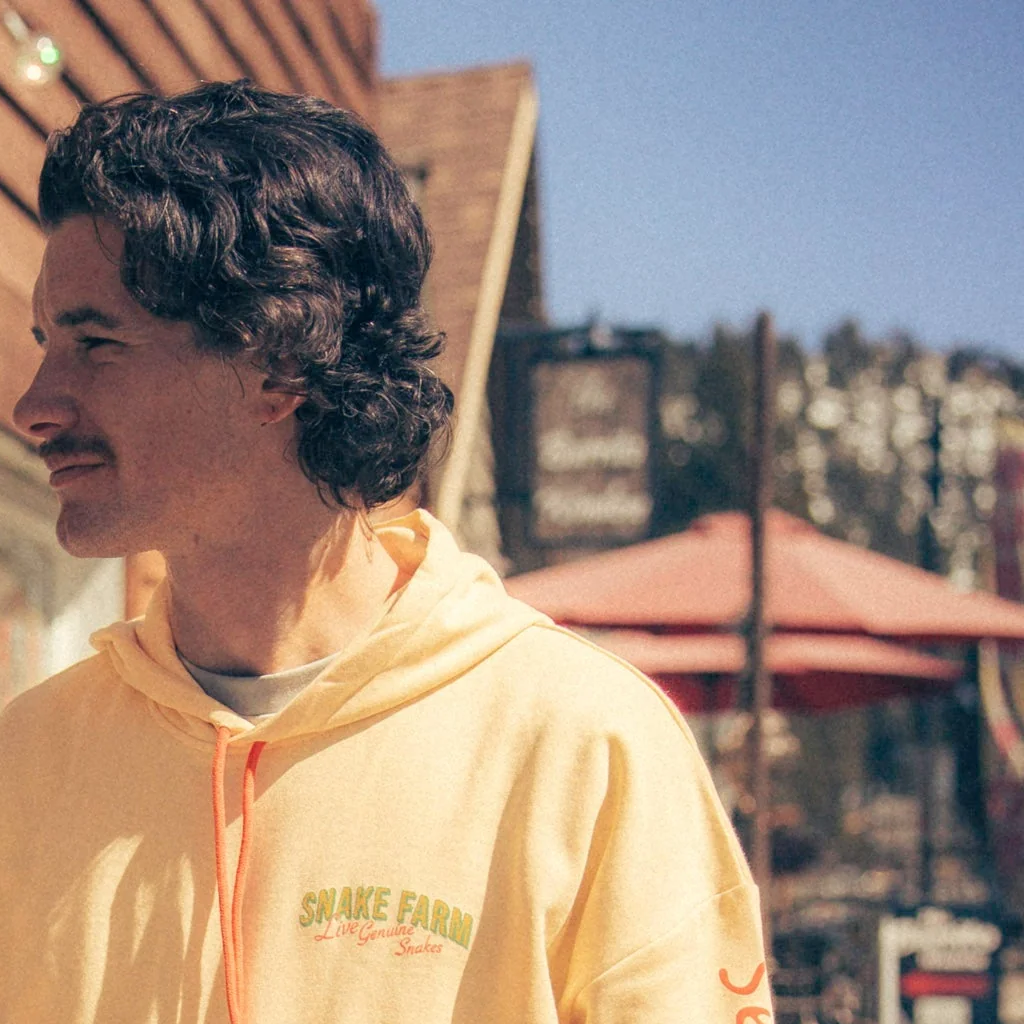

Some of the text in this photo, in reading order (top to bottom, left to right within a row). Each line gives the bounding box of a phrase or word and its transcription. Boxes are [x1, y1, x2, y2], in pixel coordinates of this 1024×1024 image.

[299, 886, 473, 950] SNAKE FARM
[314, 913, 415, 946] Live Genuine
[394, 935, 444, 956] Snakes
